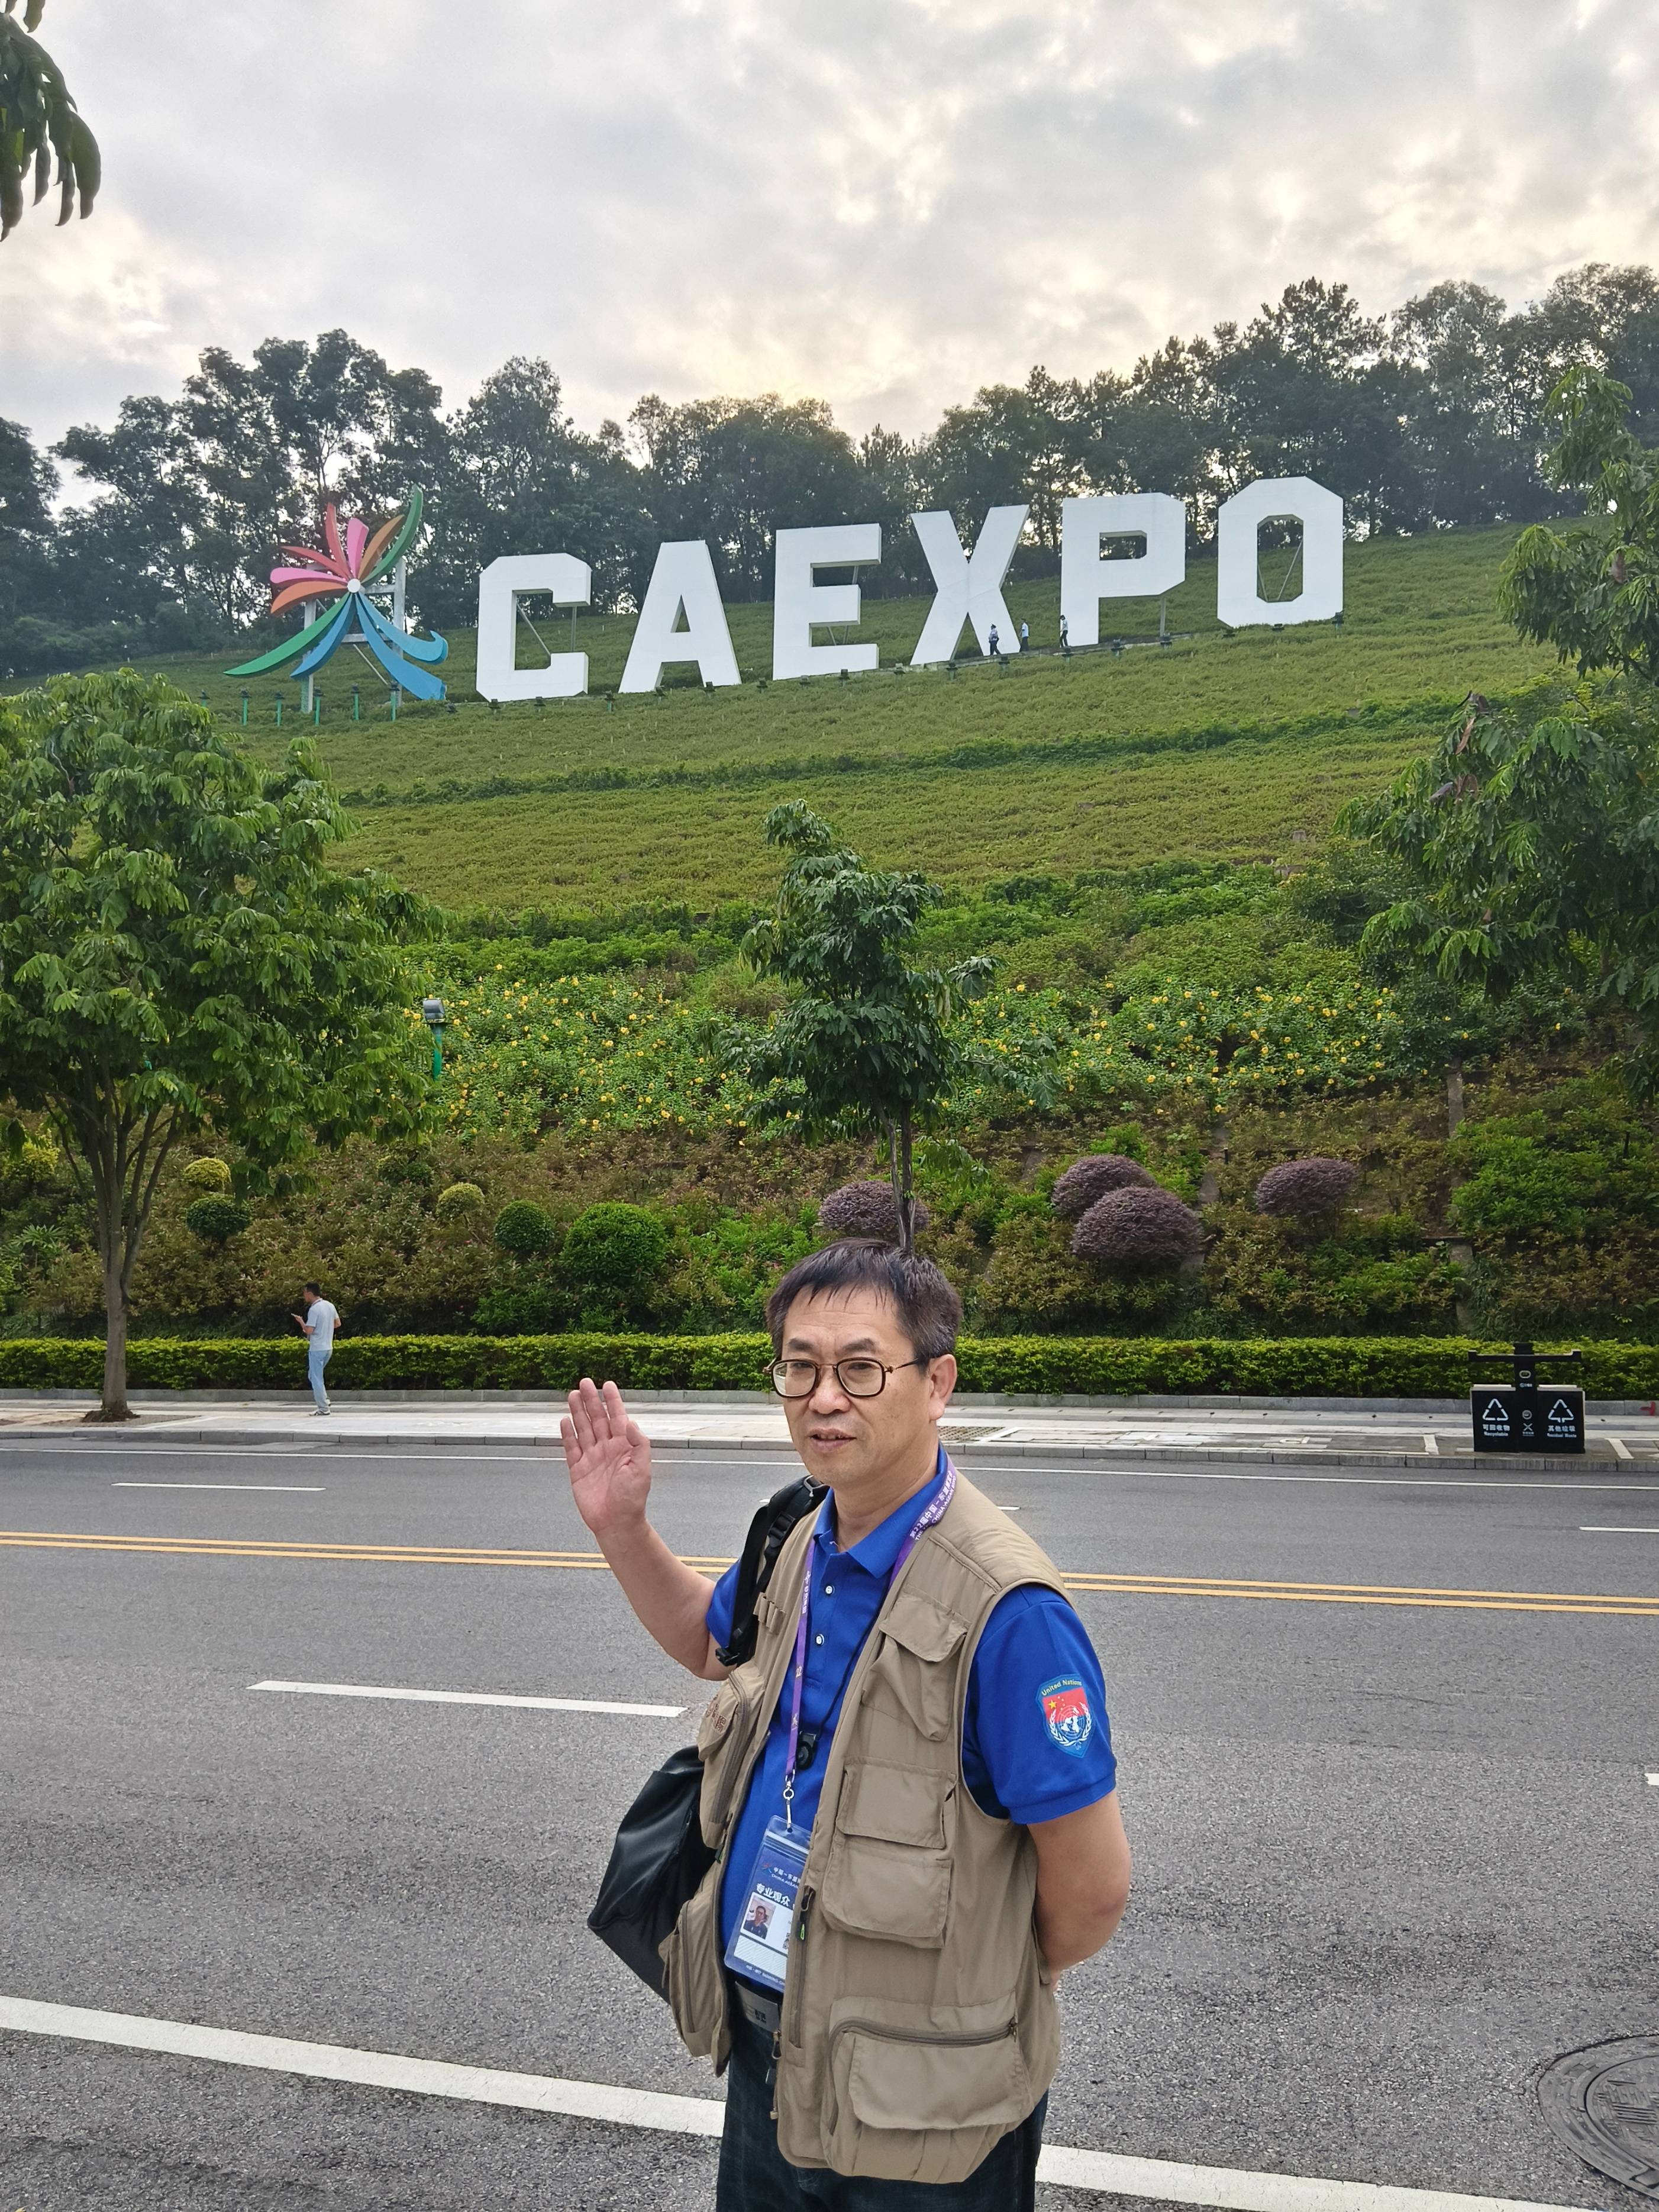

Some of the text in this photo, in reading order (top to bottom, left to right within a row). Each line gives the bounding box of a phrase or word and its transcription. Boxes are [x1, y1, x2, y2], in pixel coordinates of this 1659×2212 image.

[476, 476, 1344, 702] CAEXPO
[1041, 1678, 1082, 1696] United Nations
[756, 1883, 790, 1907] 专业观众
